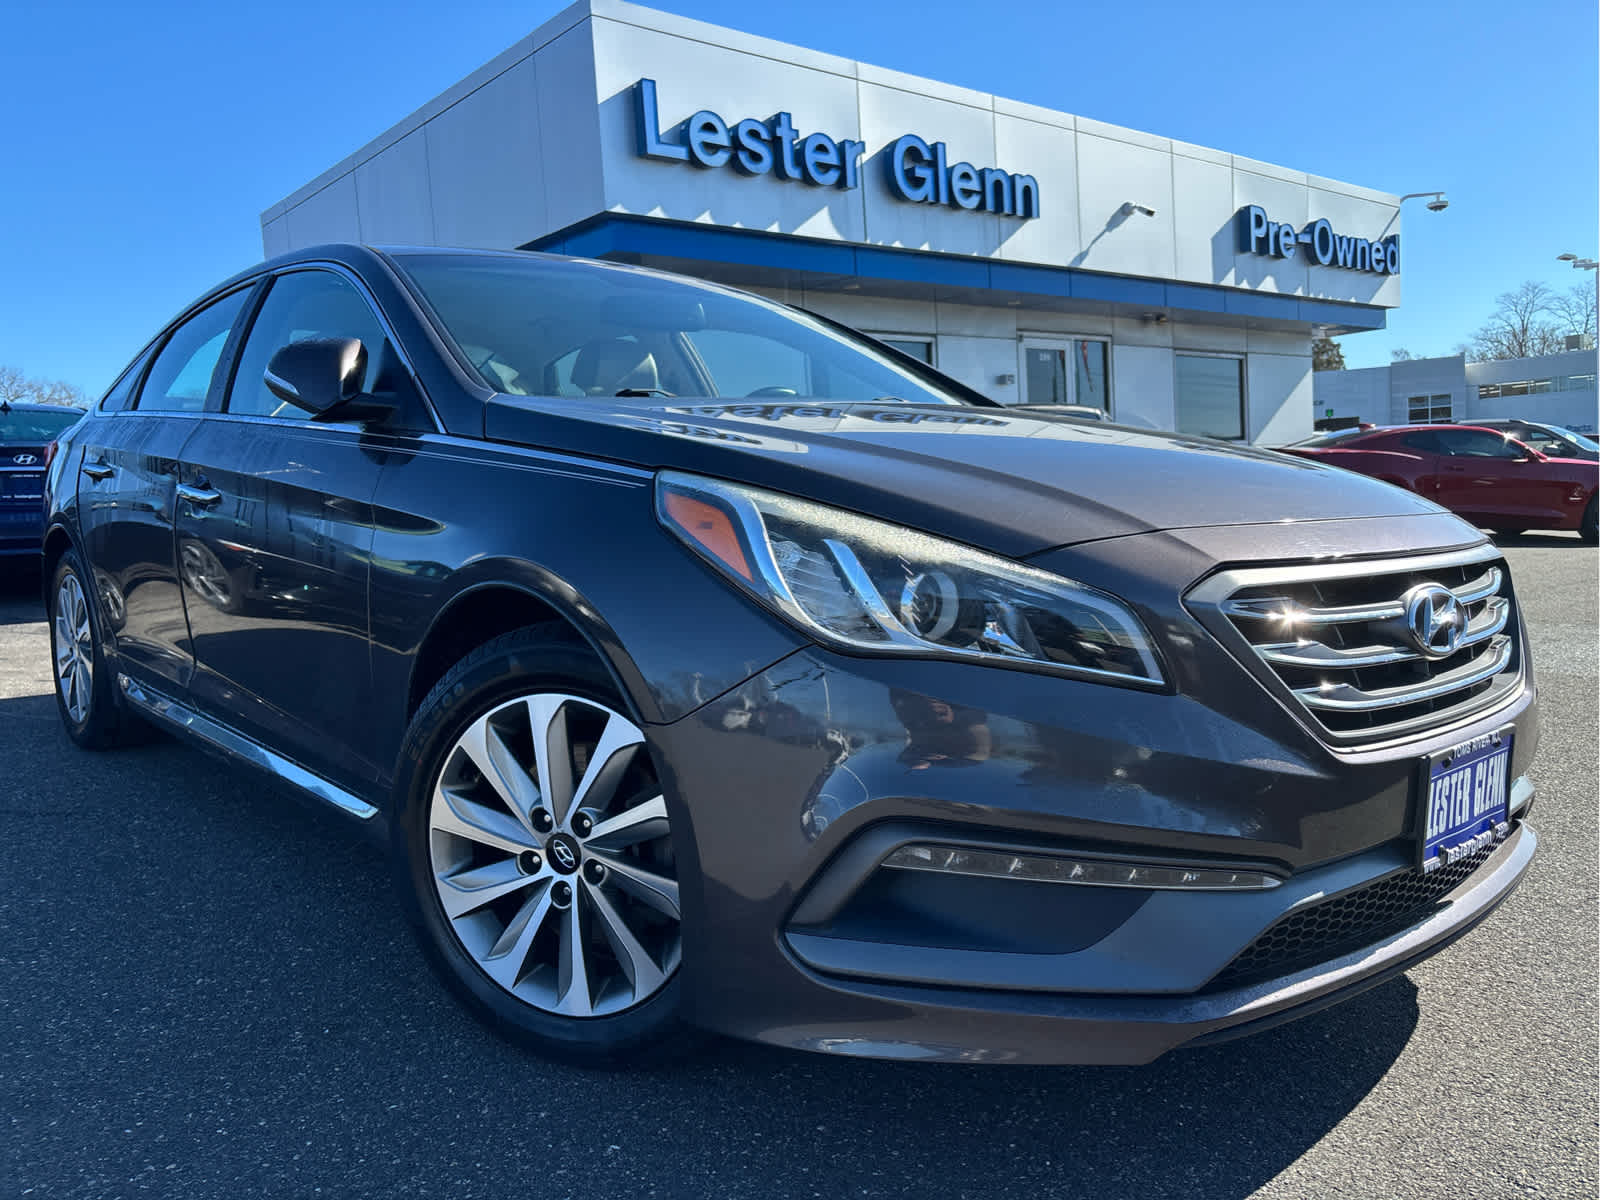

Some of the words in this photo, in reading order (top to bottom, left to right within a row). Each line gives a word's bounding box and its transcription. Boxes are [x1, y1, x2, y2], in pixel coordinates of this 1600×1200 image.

[637, 77, 866, 190] Lester
[887, 133, 1041, 219] Glenn
[1243, 204, 1400, 275] Pre-Owned
[1427, 767, 1471, 840] LESTER
[1474, 751, 1508, 817] GLENN
